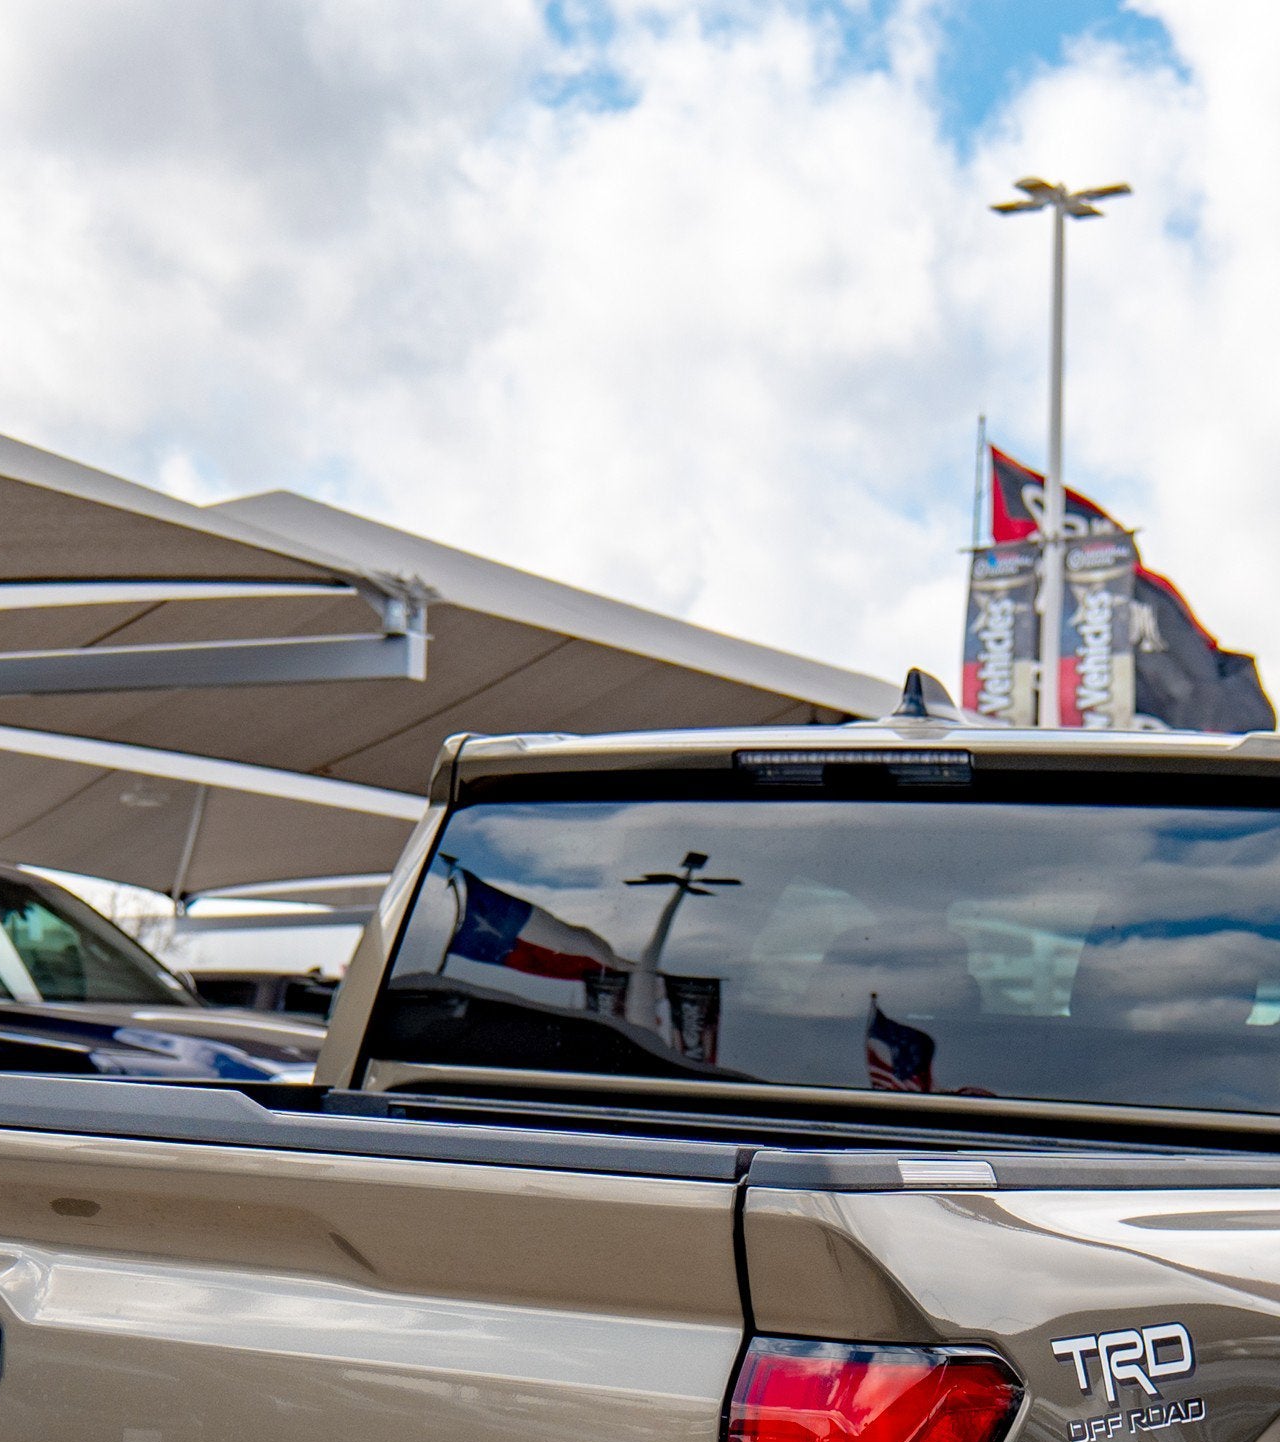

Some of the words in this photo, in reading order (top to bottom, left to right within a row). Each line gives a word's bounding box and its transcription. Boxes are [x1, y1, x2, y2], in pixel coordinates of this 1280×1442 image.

[976, 597, 1015, 713] Vehicles
[1076, 590, 1113, 708] Vehicles
[1050, 1321, 1195, 1408] TRD
[1126, 1398, 1206, 1434] ROAD
